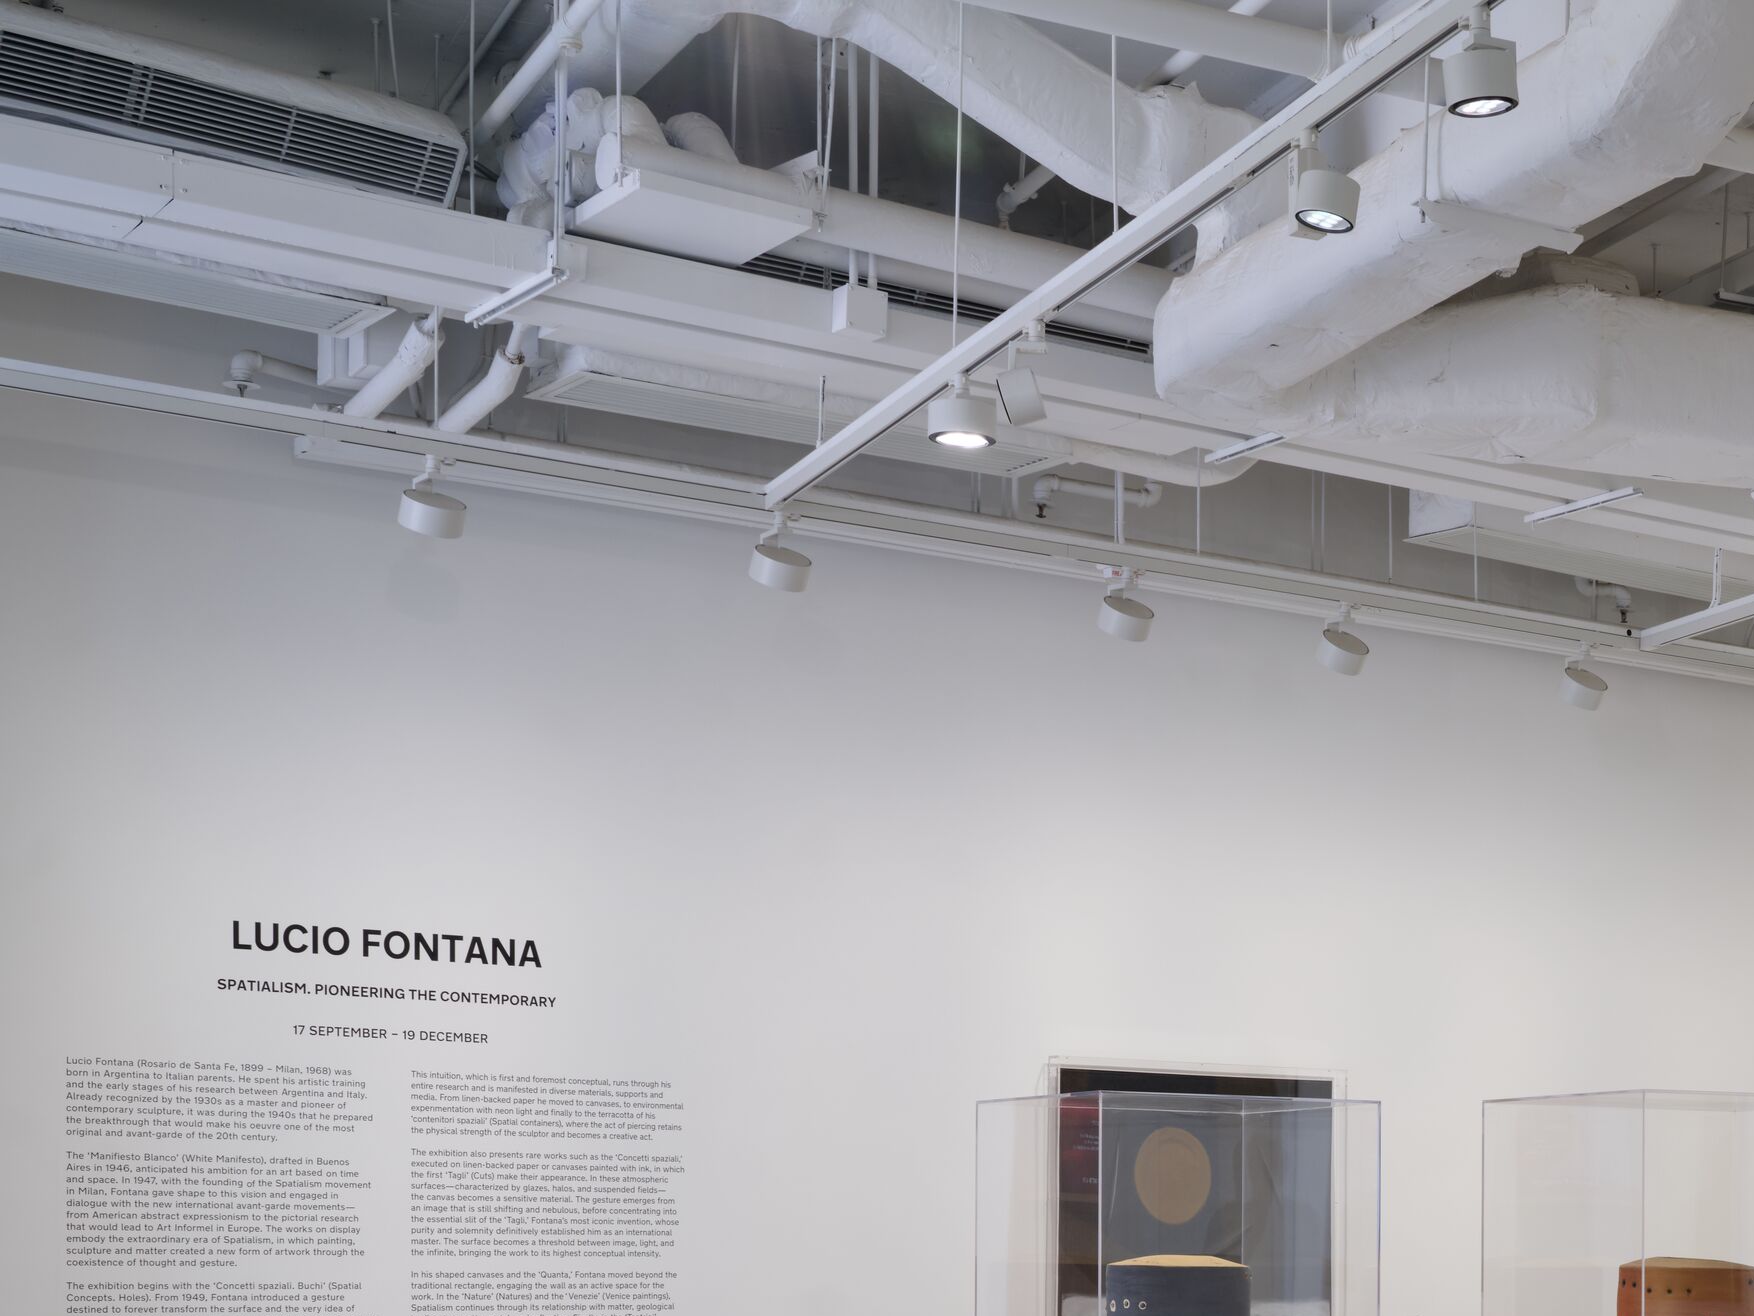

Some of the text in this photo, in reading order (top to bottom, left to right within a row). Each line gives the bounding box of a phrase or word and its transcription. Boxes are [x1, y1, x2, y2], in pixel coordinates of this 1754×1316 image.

[232, 920, 542, 969] LUCIO FONTANA
[315, 983, 405, 1000] PIONEERING
[408, 988, 437, 1002] THE
[440, 990, 557, 1008] CONTEMPORARY
[293, 1024, 306, 1035] 17
[309, 1025, 387, 1039] SEPTEMBER
[402, 1030, 416, 1041] 19
[419, 1030, 488, 1044] DECEMBER
[66, 1055, 92, 1065] Lucio
[95, 1056, 134, 1066] Fontana
[136, 1058, 176, 1070] (Rosario
[179, 1060, 191, 1069] de
[194, 1060, 220, 1070] Santa
[240, 1062, 263, 1072] 1899
[306, 1065, 331, 1077] 1968)
[334, 1068, 352, 1076] was
[66, 1091, 102, 1103] Already
[106, 1092, 158, 1105] recognized
[161, 1094, 172, 1105] by
[176, 1094, 190, 1103] the
[194, 1095, 222, 1105] 1930s
[246, 1097, 278, 1107] master
[280, 1098, 297, 1107] and
[300, 1099, 334, 1111] pioneer
[337, 1100, 346, 1109] of
[65, 1126, 102, 1138] original
[104, 1127, 122, 1136] and
[126, 1128, 182, 1140] avant-garde
[185, 1129, 195, 1138] of
[198, 1130, 213, 1139] the
[216, 1130, 238, 1139] 20th
[410, 1124, 424, 1133] the
[426, 1125, 457, 1137] physical
[459, 1126, 492, 1138] strength
[494, 1127, 502, 1136] of
[503, 1127, 516, 1136] the
[518, 1128, 548, 1139] sculptor
[550, 1129, 565, 1138] and
[566, 1129, 600, 1139] becomes
[608, 1130, 638, 1140] creative
[66, 1150, 84, 1159] The
[181, 1153, 213, 1164] (White
[269, 1155, 302, 1164] drafted
[305, 1156, 313, 1165] in
[316, 1156, 349, 1166] Buenos
[66, 1198, 107, 1209] dialogue
[110, 1198, 131, 1207] with
[134, 1199, 149, 1207] the
[175, 1199, 233, 1209] international
[236, 1200, 290, 1212] avant-garde
[410, 1191, 424, 1200] the
[426, 1193, 455, 1201] canvas
[457, 1192, 494, 1201] becomes
[503, 1193, 537, 1202] sensitive
[539, 1194, 573, 1203] material.
[575, 1194, 590, 1203] The
[592, 1194, 620, 1206] gesture
[622, 1197, 655, 1206] emerges
[657, 1196, 675, 1204] from
[66, 1209, 358, 1224] from American abstract expressionism to the pictorial research
[410, 1225, 434, 1236] purity
[436, 1225, 452, 1234] and
[454, 1225, 493, 1236] solemnity
[495, 1226, 538, 1237] definitively
[540, 1226, 585, 1235] established
[587, 1226, 601, 1235] him
[625, 1227, 672, 1236] international
[66, 1245, 111, 1256] sculpture
[114, 1245, 132, 1254] and
[135, 1246, 166, 1254] matter
[169, 1246, 205, 1255] created
[238, 1246, 260, 1255] form
[262, 1246, 272, 1255] of
[274, 1247, 310, 1255] artwork
[313, 1247, 348, 1258] through
[350, 1247, 364, 1256] the
[66, 1257, 237, 1268] coexistence of thought and gesture.
[410, 1269, 418, 1278] In
[420, 1269, 432, 1278] his
[435, 1269, 464, 1280] shaped
[506, 1270, 521, 1278] and
[523, 1270, 536, 1278] the
[574, 1270, 605, 1278] Fontana
[607, 1270, 633, 1278] moved
[635, 1270, 663, 1280] beyond
[665, 1270, 677, 1278] the
